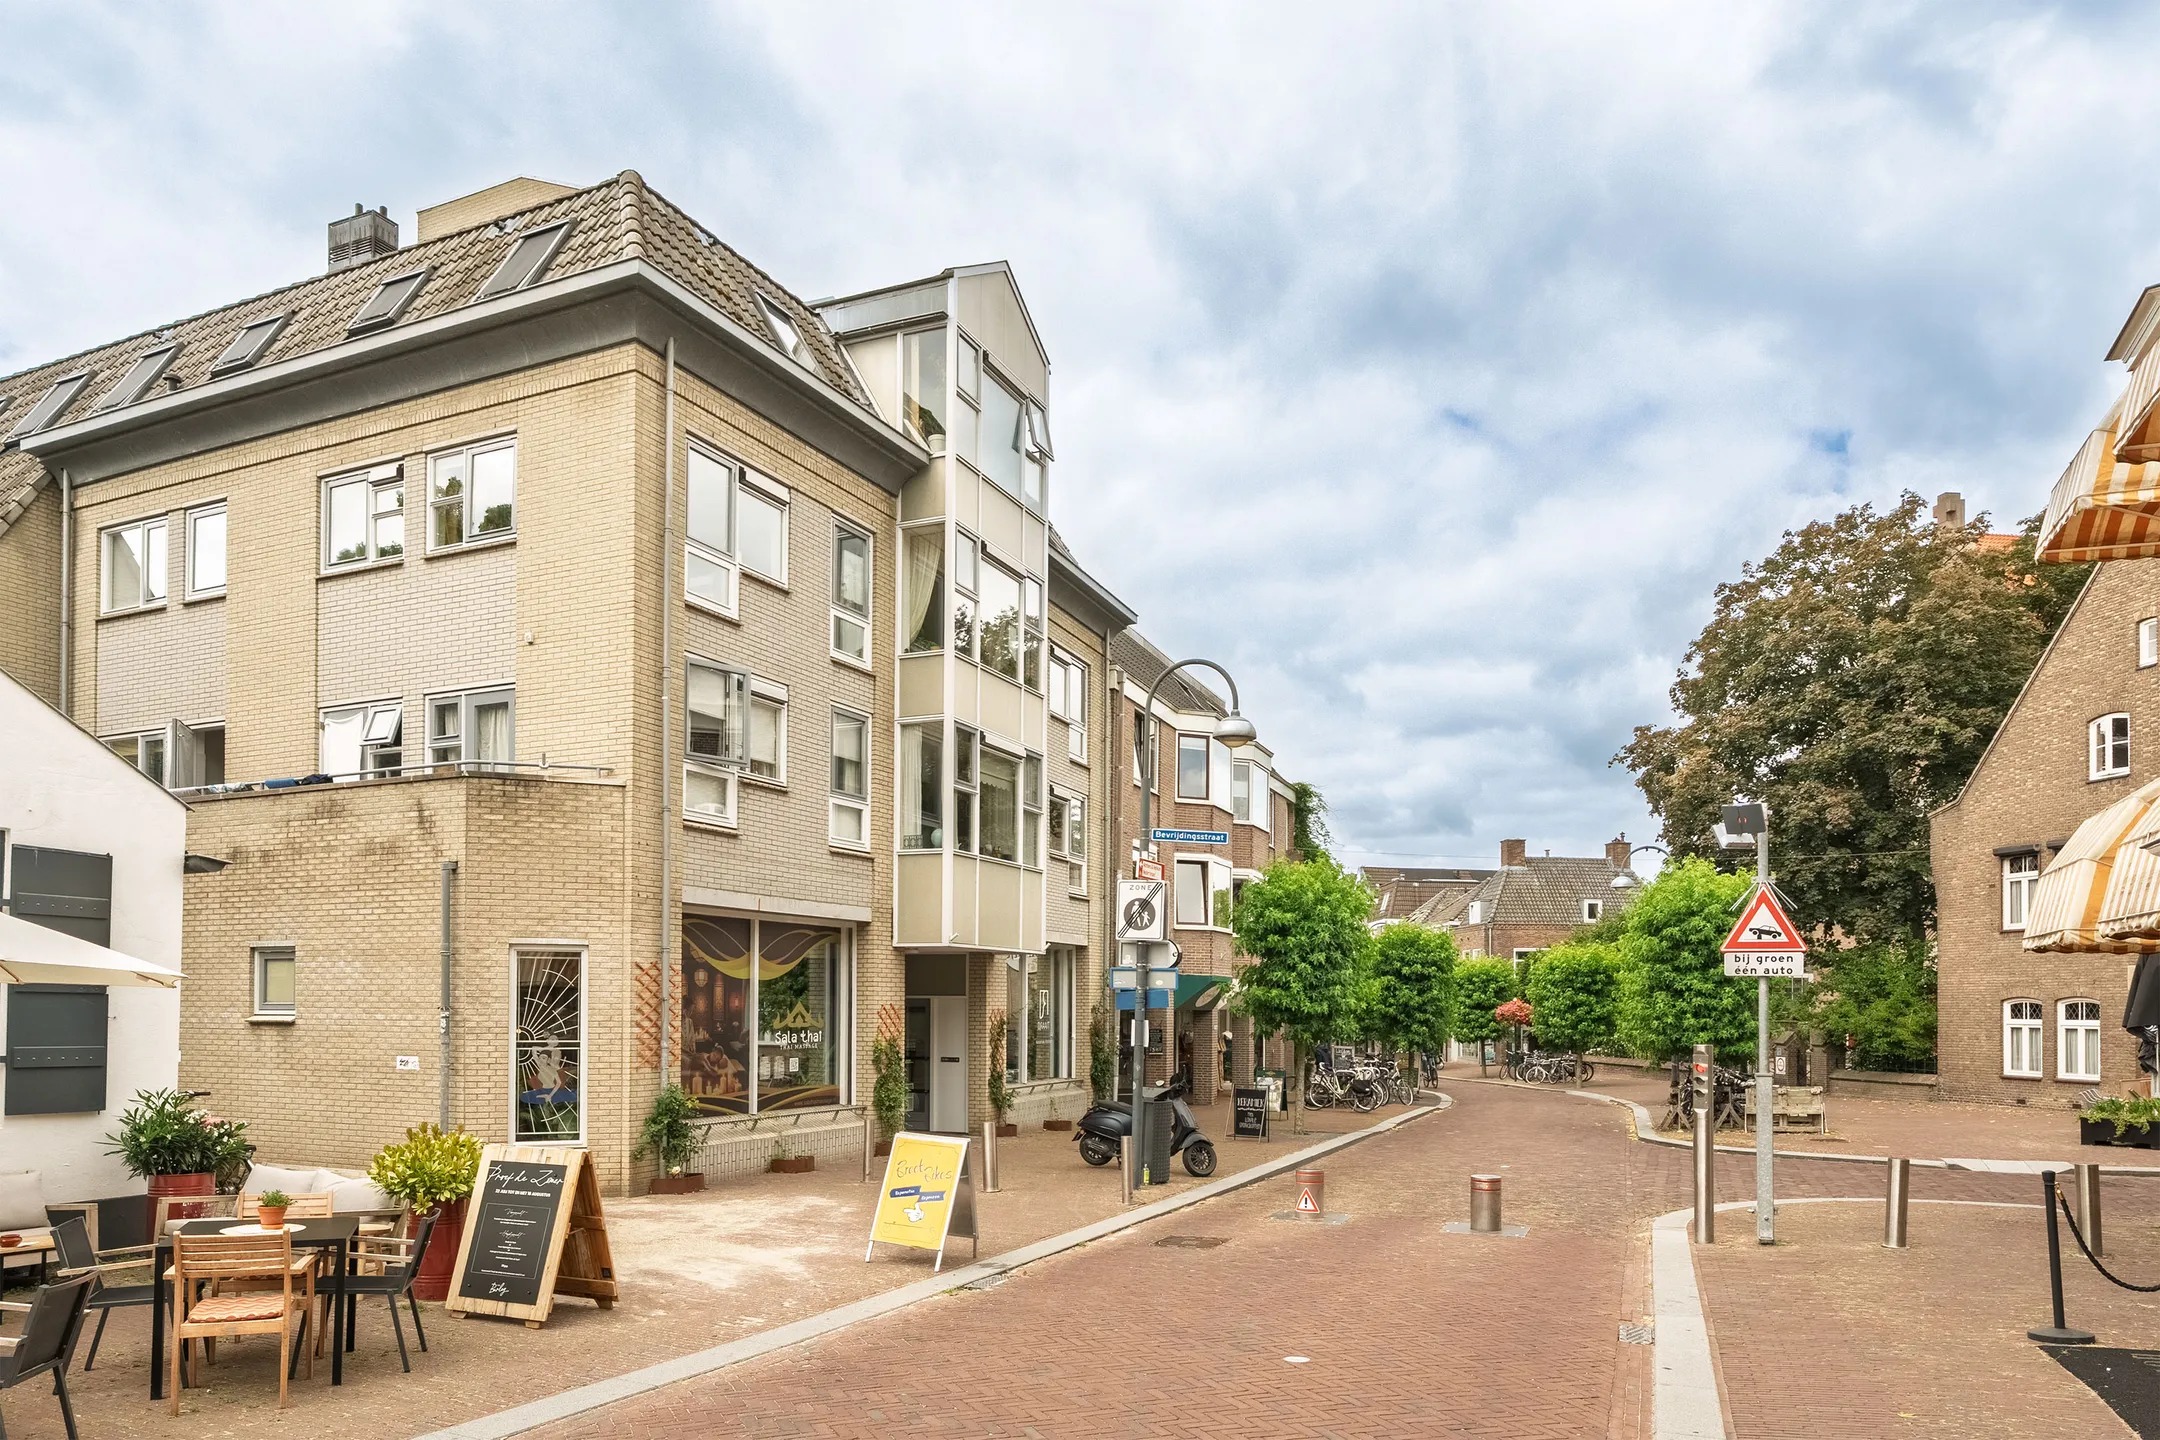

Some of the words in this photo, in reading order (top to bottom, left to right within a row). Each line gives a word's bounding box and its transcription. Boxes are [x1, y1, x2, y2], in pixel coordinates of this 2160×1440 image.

[1155, 831, 1225, 841] Bevrijdingsstraat
[1734, 954, 1750, 965] bij
[1756, 955, 1794, 965] groen
[1734, 966, 1757, 975] één
[1763, 966, 1793, 975] auto
[775, 1031, 798, 1044] Sala
[800, 1030, 822, 1042] thai
